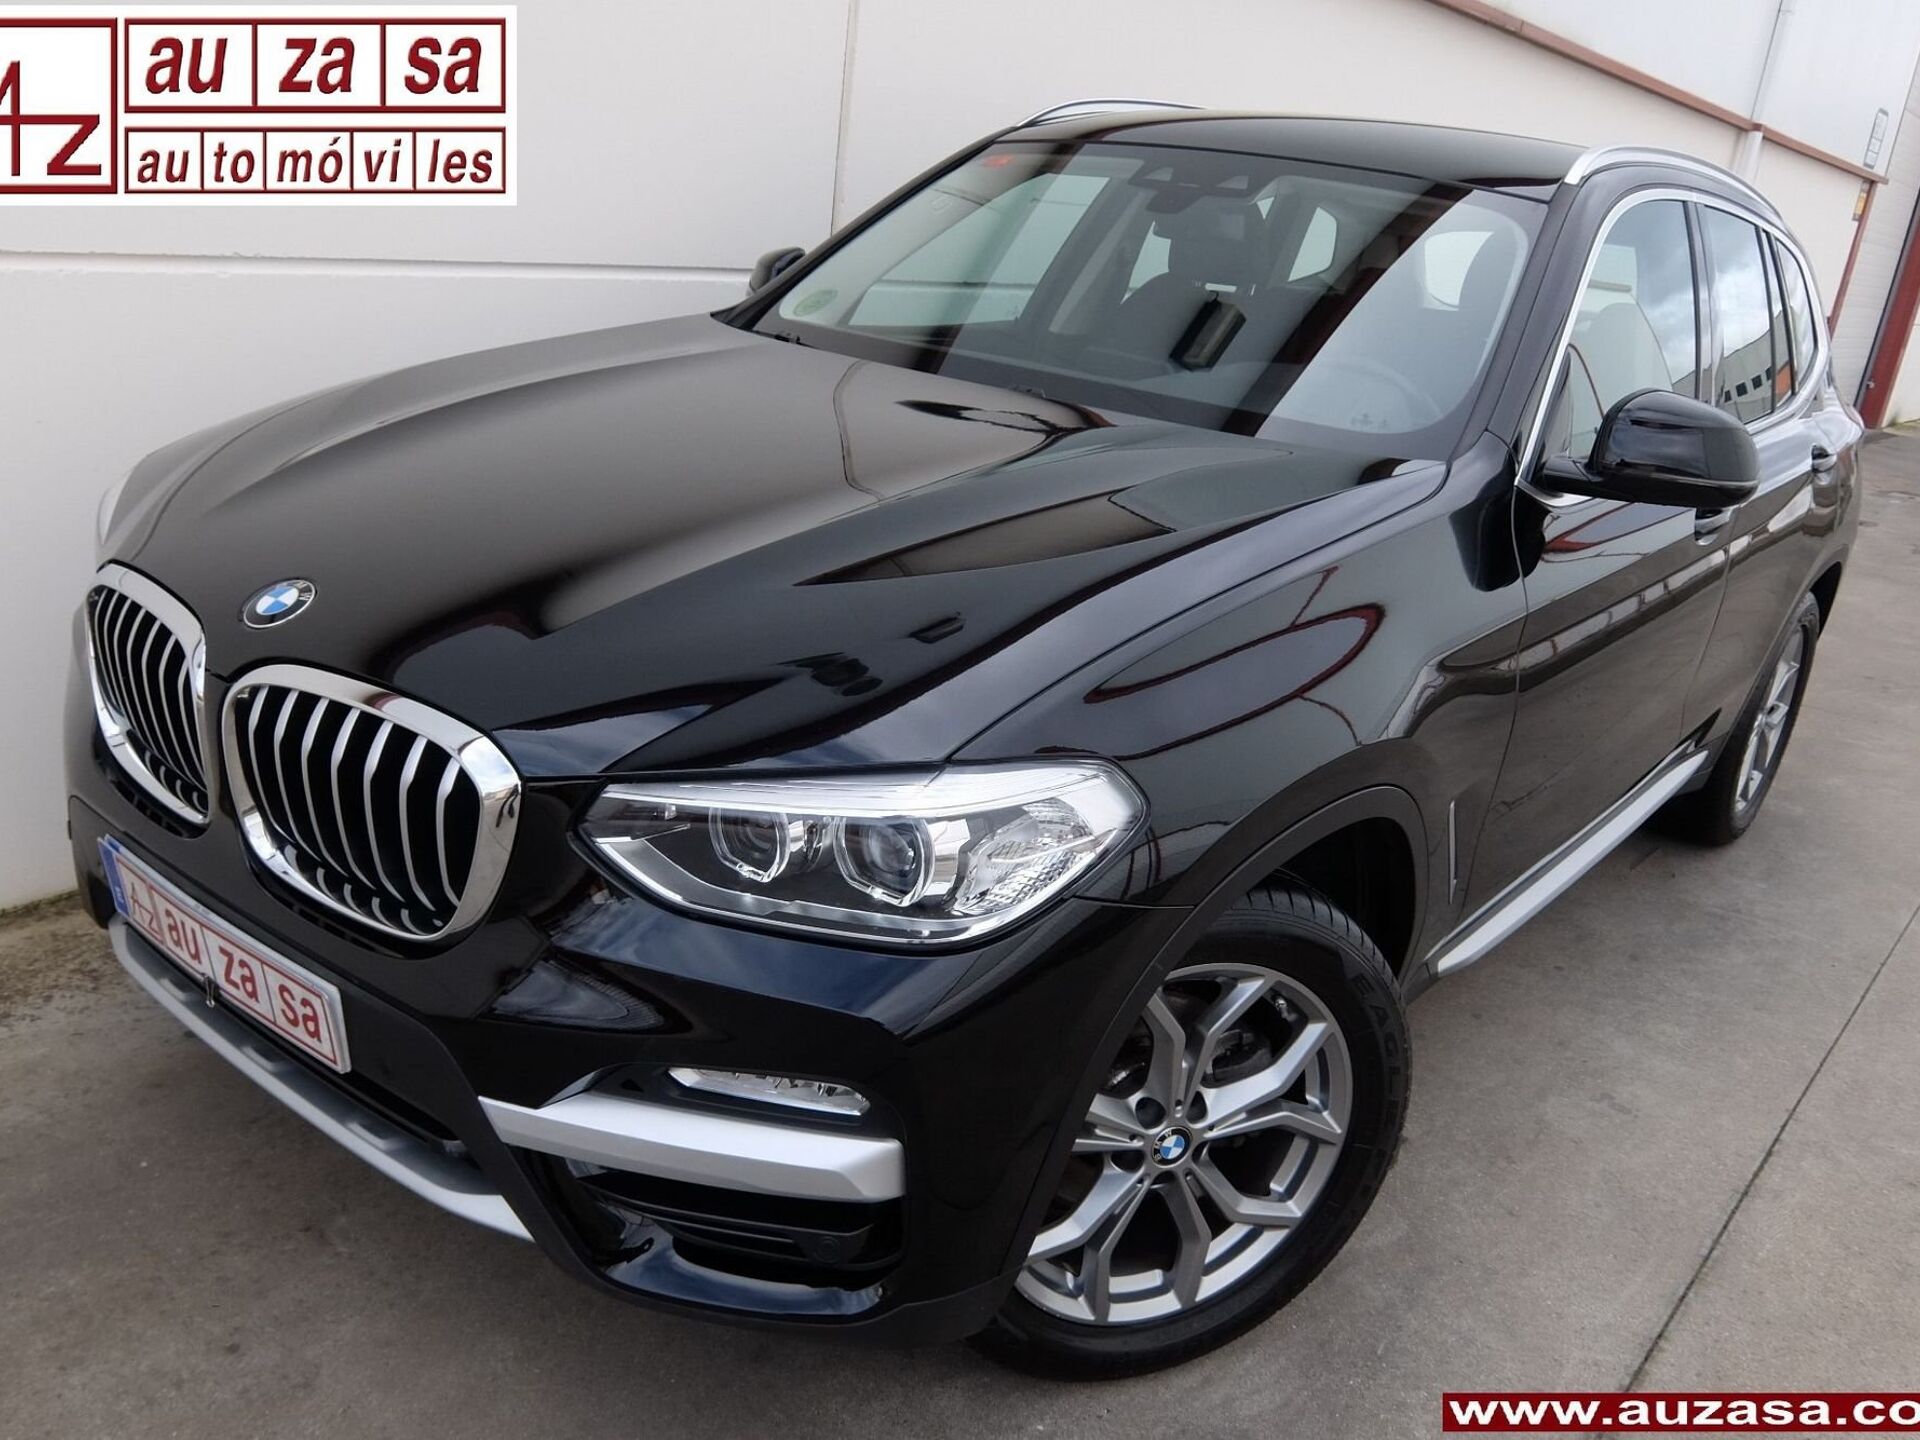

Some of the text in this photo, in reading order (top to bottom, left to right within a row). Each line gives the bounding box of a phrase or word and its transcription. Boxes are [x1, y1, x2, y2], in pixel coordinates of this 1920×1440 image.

[165, 908, 322, 1043] au za sa
